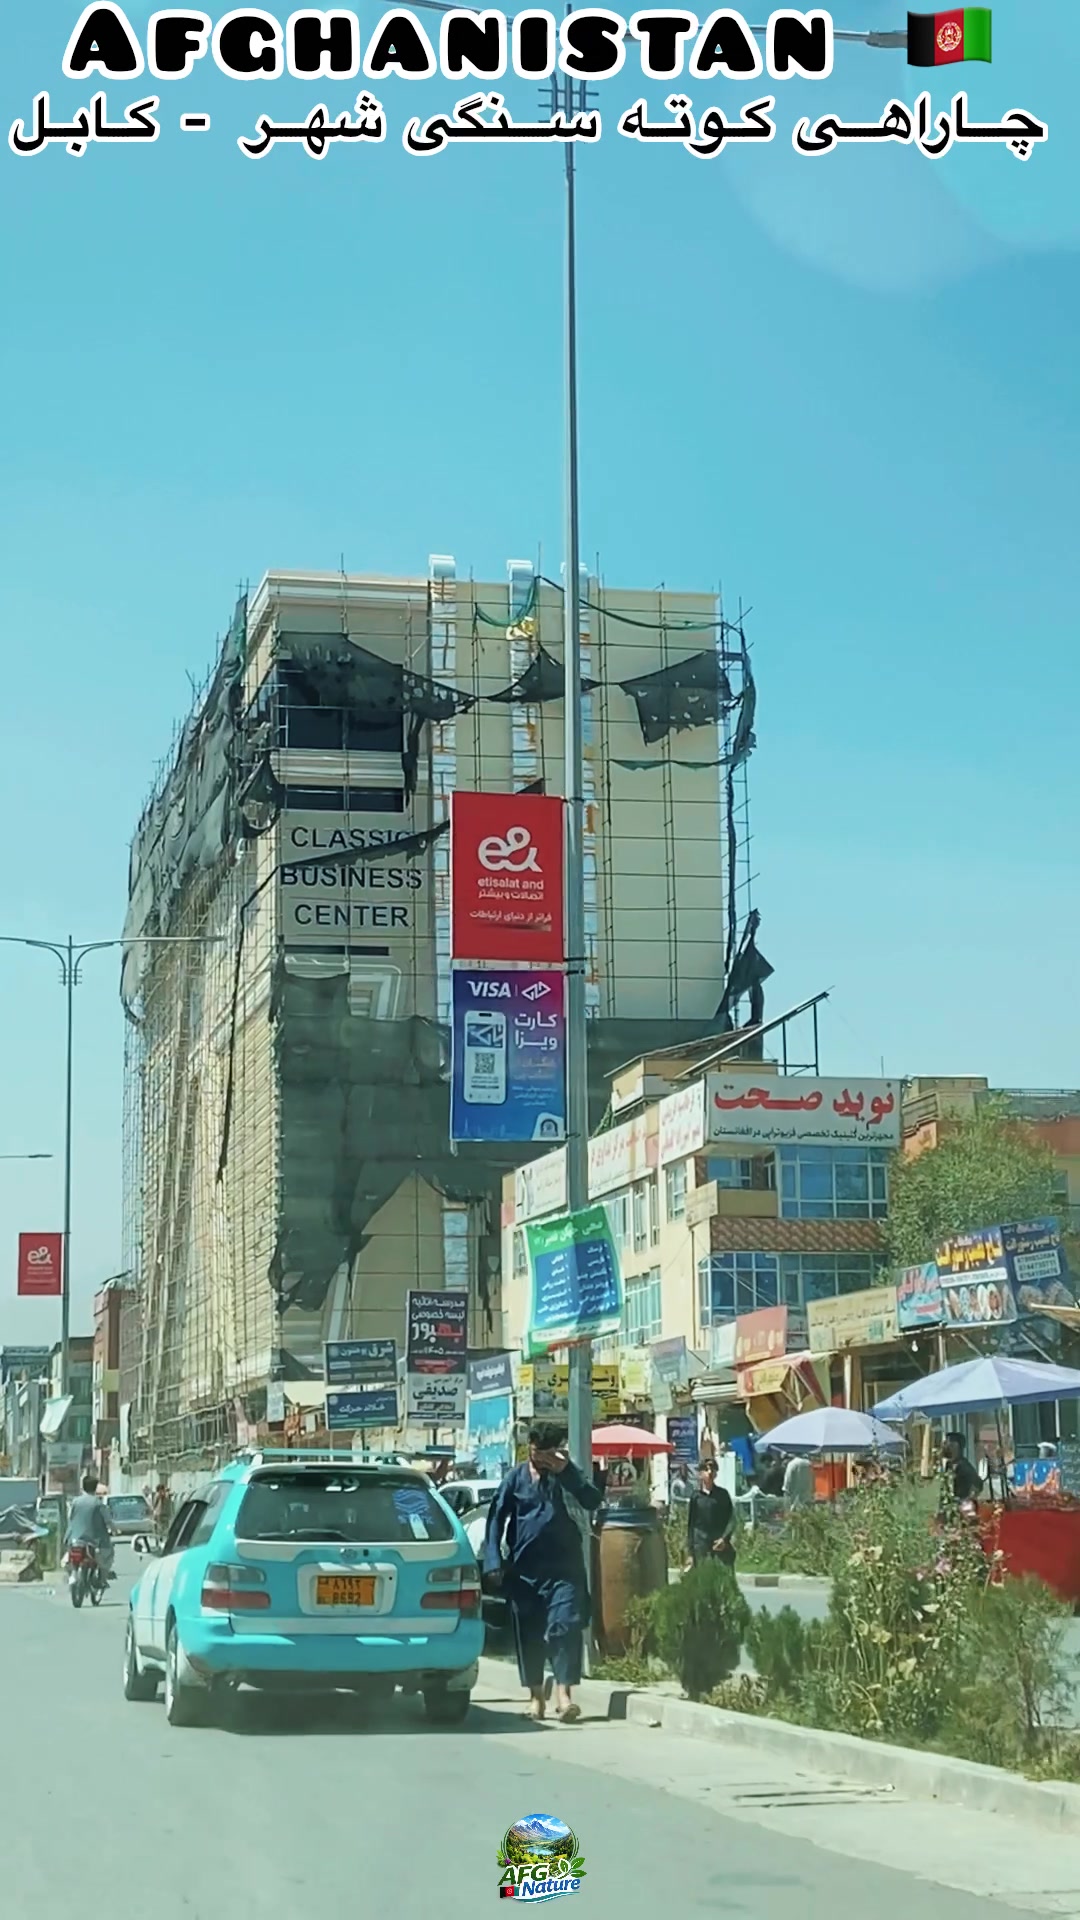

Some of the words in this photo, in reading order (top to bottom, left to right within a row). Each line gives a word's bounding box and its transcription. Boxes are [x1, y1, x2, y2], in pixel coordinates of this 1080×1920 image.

[280, 865, 423, 889] BUSINESS
[477, 877, 520, 889] etisalat
[522, 880, 544, 891] and
[294, 904, 410, 927] CENTER
[466, 980, 512, 998] VISA
[514, 1011, 558, 1030] کارت
[514, 1029, 558, 1050] ویزا
[714, 1084, 824, 1111] صحت
[832, 1082, 895, 1130] نوید
[412, 1382, 458, 1400] صدیقی
